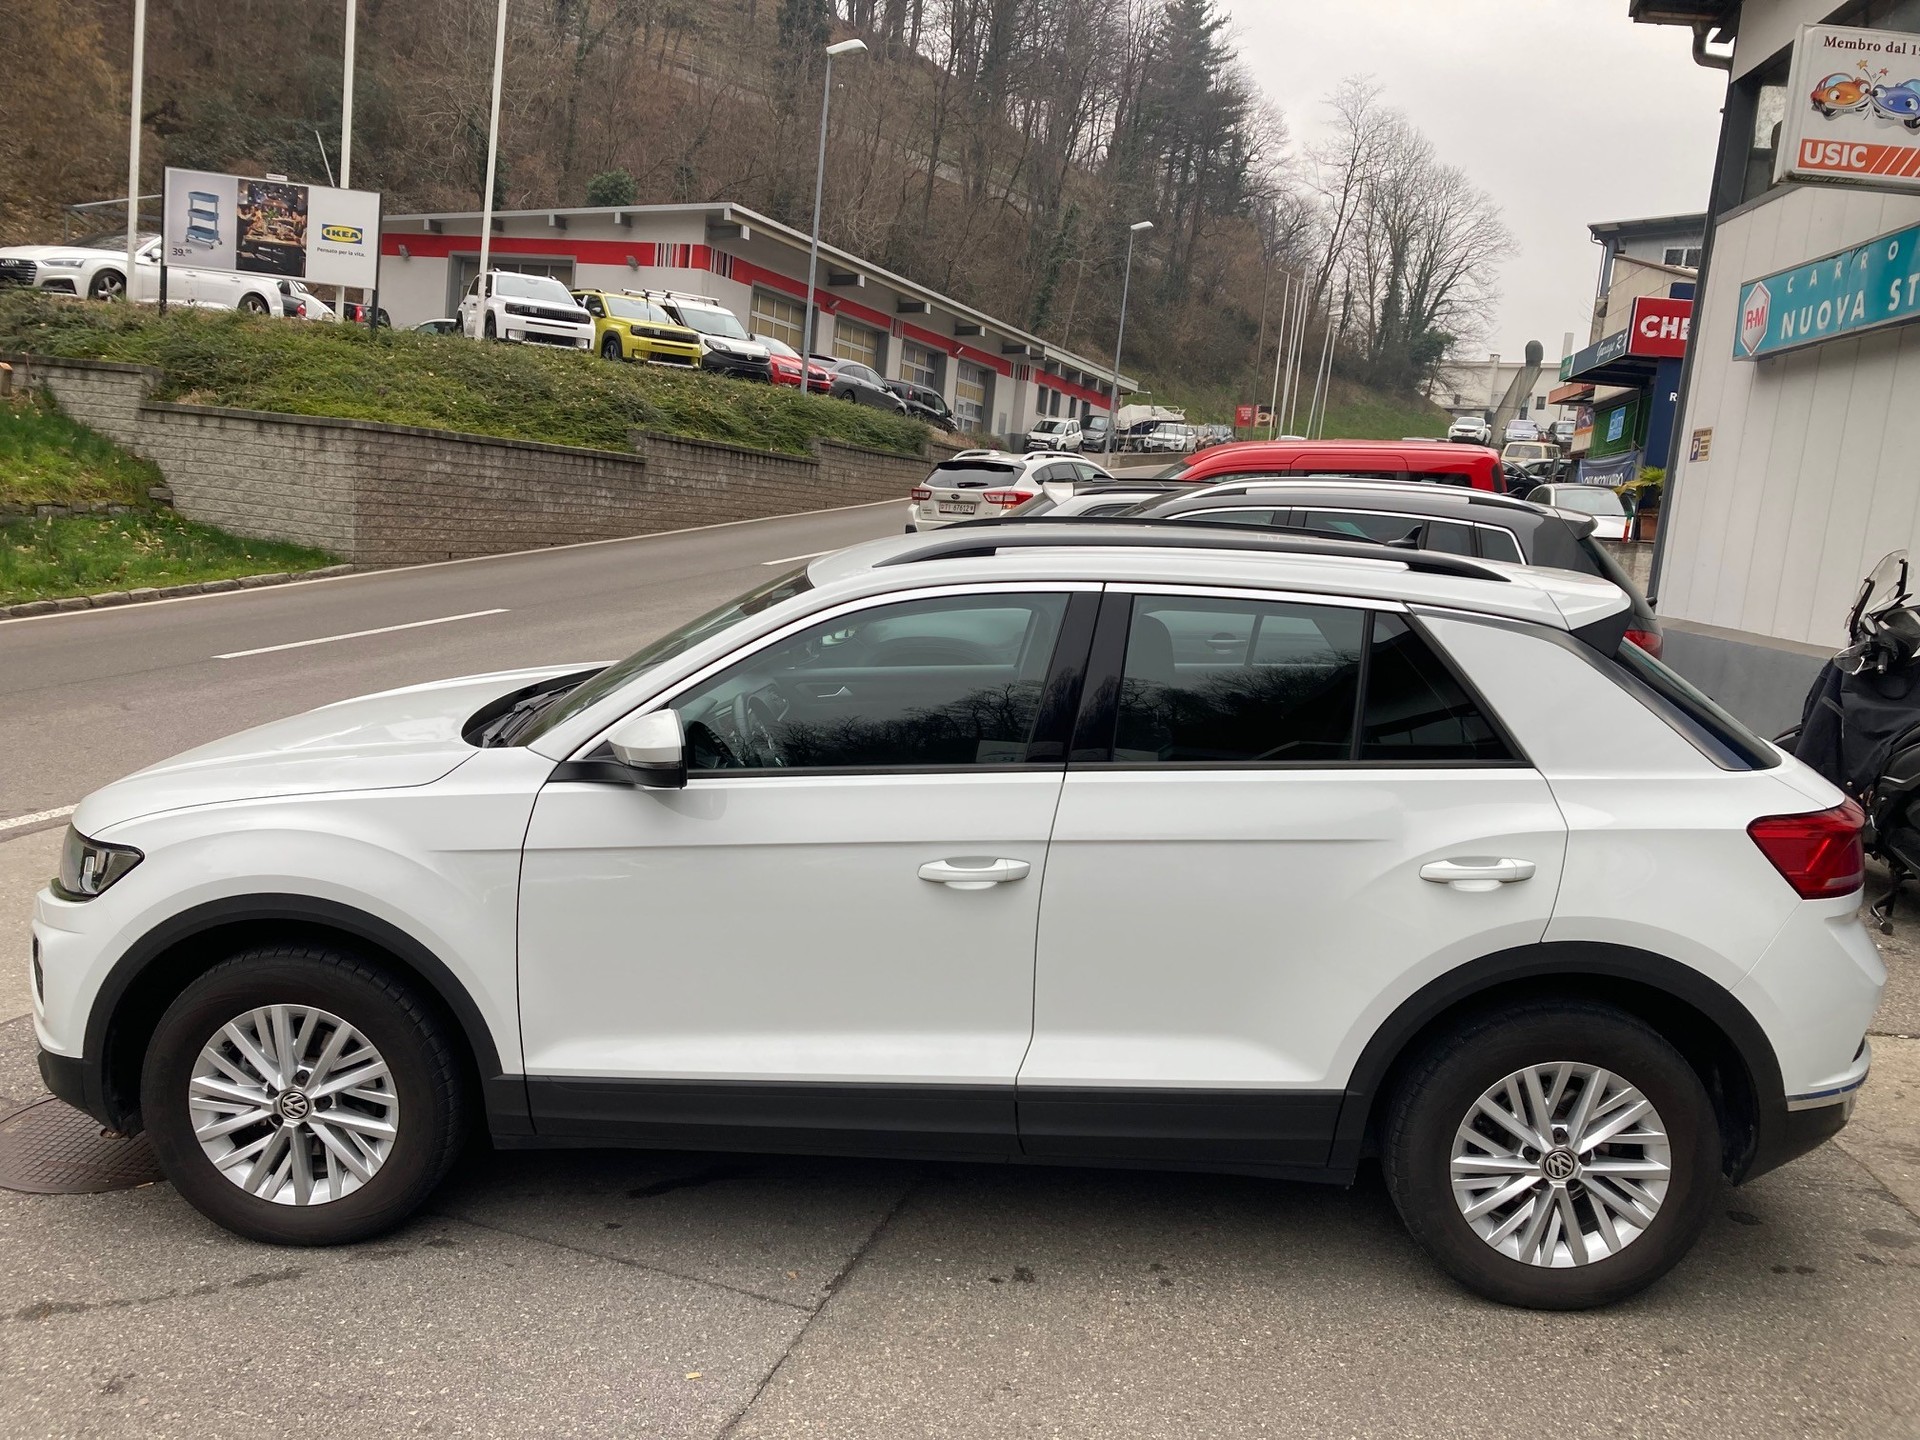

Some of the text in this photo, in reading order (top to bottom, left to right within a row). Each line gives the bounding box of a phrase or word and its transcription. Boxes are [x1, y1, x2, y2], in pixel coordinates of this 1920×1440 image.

[1824, 36, 1920, 57] Membro dal 1
[1804, 142, 1868, 168] USIC
[326, 229, 359, 239] IKEA
[1745, 304, 1766, 331] R-M
[1780, 272, 1920, 340] NUOVA ST
